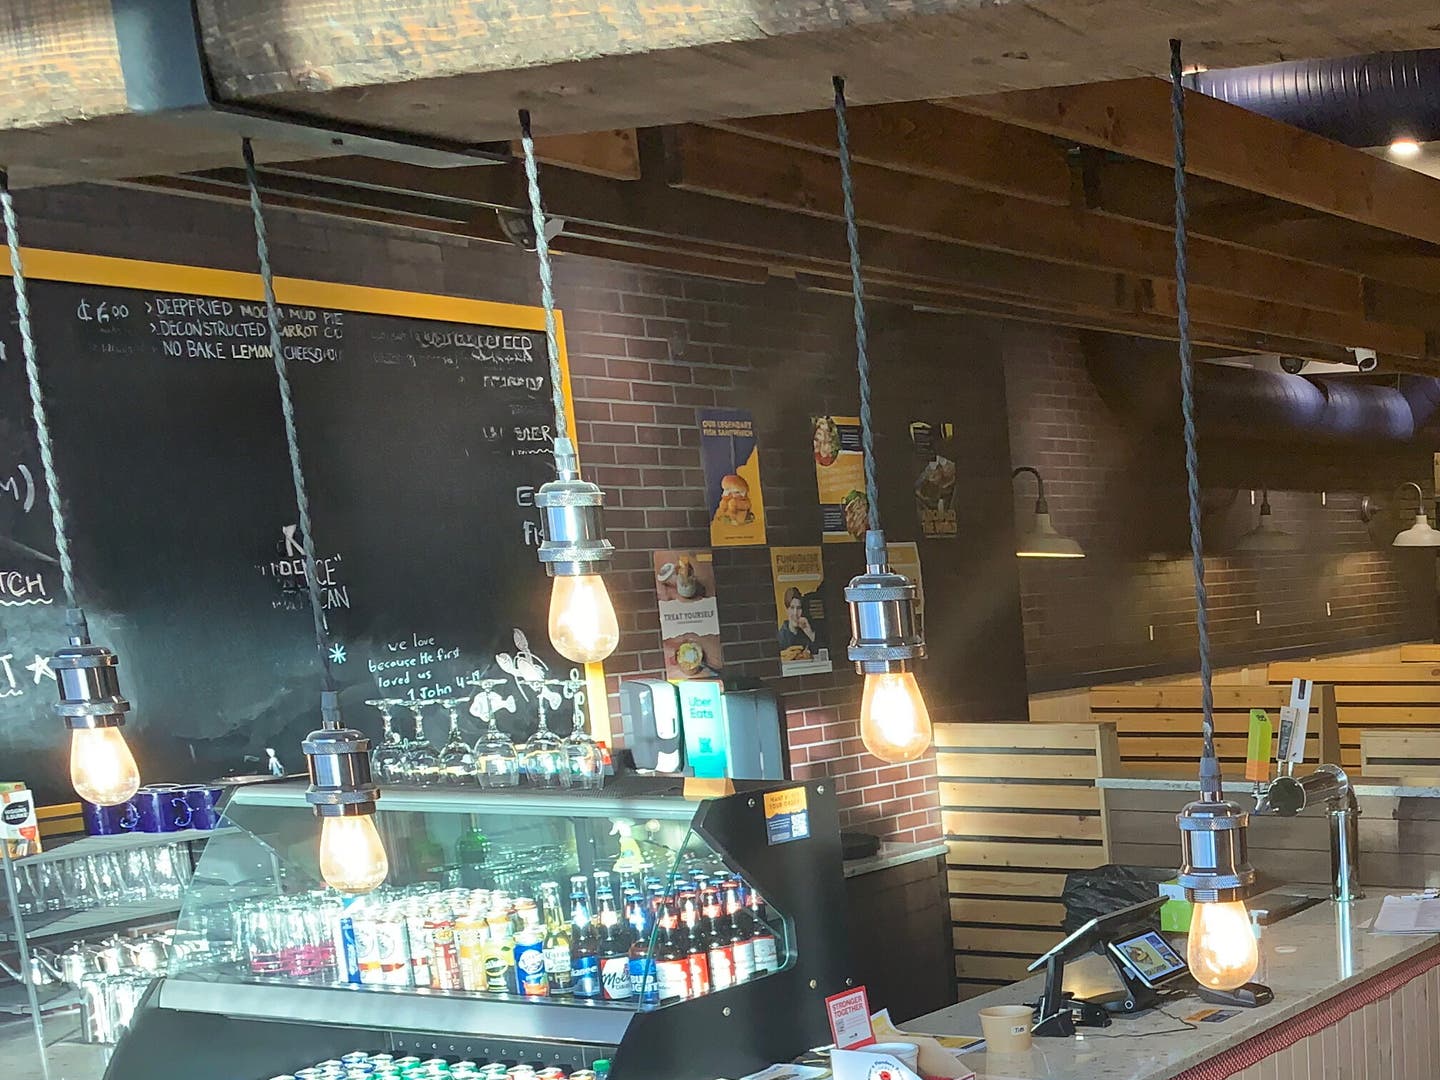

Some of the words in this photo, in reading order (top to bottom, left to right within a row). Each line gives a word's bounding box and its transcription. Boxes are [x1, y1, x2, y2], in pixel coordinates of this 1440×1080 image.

[157, 299, 233, 317] DEEPFRIED
[289, 308, 316, 321] MUD
[323, 312, 344, 326] PIE
[160, 320, 266, 337] DECONSTRUCTED
[278, 323, 319, 338] ARROT
[163, 340, 182, 357] NO
[188, 340, 225, 359] BAKE
[232, 344, 274, 360] LEMON
[664, 613, 683, 621] TREAT
[684, 610, 714, 620] YOURSELF
[388, 641, 407, 651] we
[413, 633, 435, 647] love
[368, 659, 416, 673] because
[419, 652, 434, 665] He
[436, 647, 460, 661] first
[378, 671, 410, 688] loved
[418, 670, 432, 680] us
[419, 683, 452, 699] John
[689, 696, 712, 707] Uber
[690, 708, 713, 719] Eats
[832, 995, 863, 1011] STRONGER
[834, 1003, 864, 1018] TOGETHER
